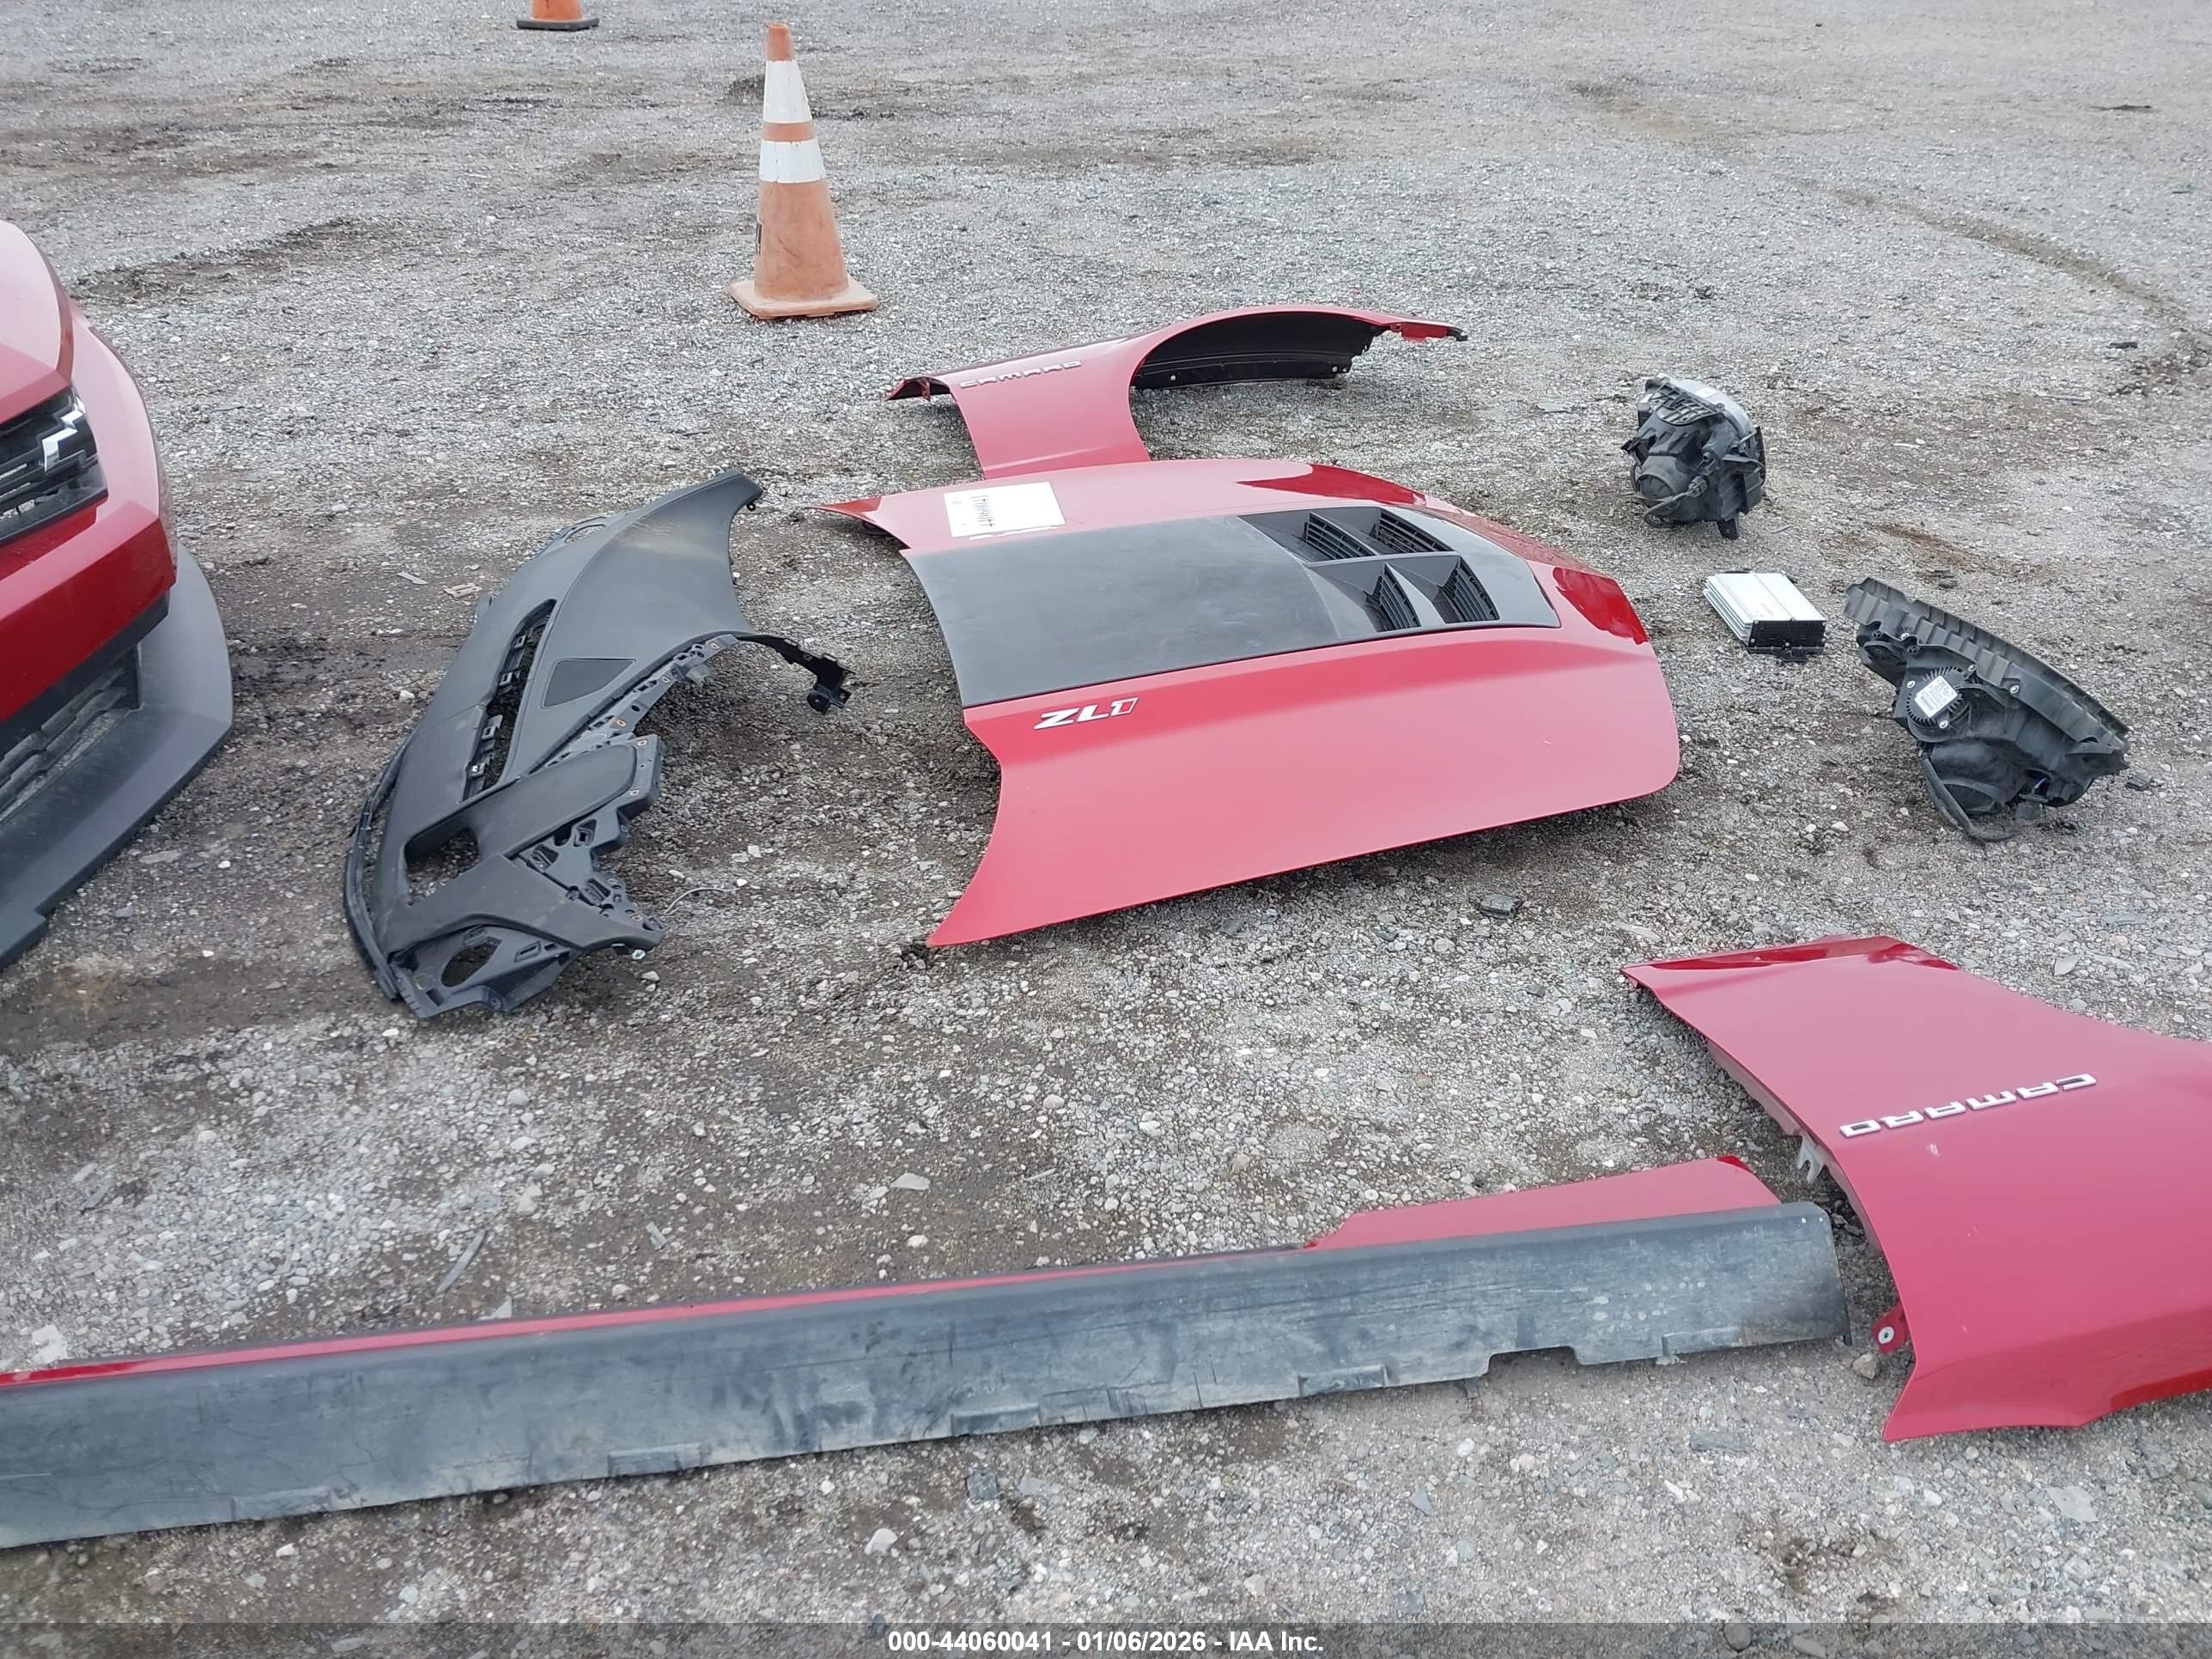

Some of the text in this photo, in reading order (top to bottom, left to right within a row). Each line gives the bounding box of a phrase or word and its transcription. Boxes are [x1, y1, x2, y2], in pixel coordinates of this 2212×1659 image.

[960, 361, 1082, 389] CAMARO
[1033, 696, 1139, 730] ZL1
[1838, 1073, 2098, 1139] CAMARO
